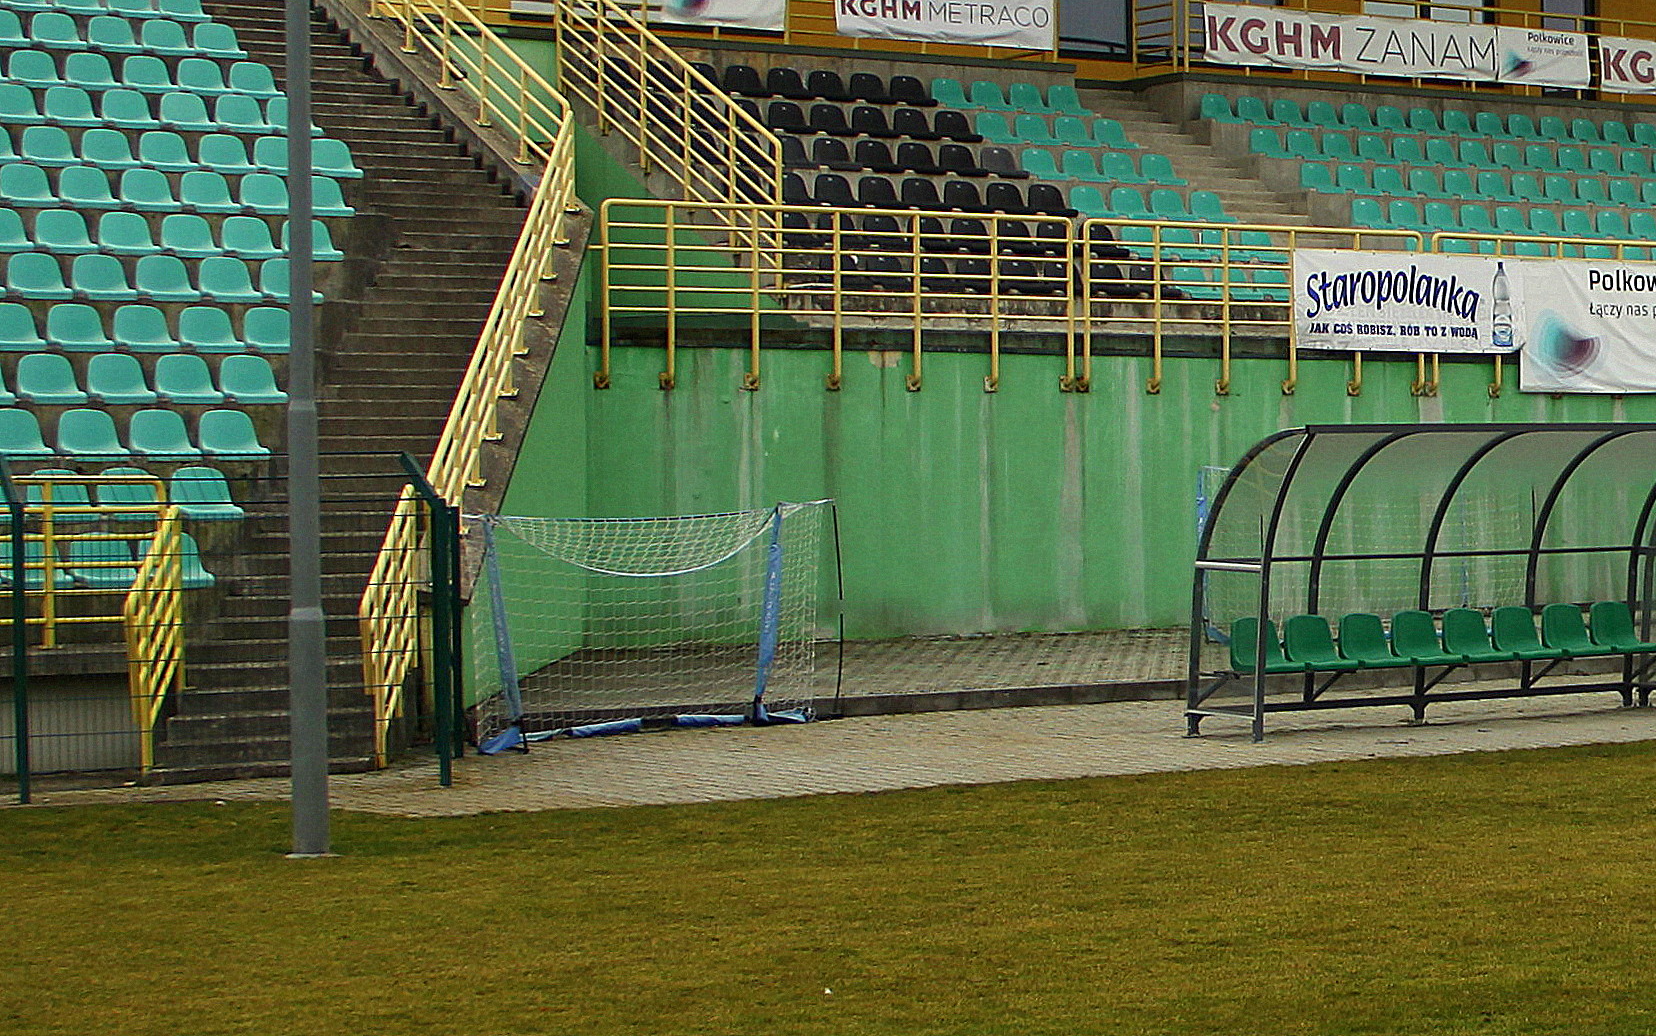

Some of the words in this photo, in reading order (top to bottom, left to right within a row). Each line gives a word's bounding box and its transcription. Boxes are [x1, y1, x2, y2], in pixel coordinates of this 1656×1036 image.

[929, 1, 1049, 28] METRACO
[1208, 15, 1342, 60] KGHM
[1355, 27, 1496, 70] ZANAM
[1528, 32, 1575, 45] Polkowice
[1306, 265, 1480, 323] Staropolanka
[1589, 302, 1623, 318] Łączy
[1627, 304, 1648, 317] nas
[1309, 323, 1329, 333] JAK
[1424, 326, 1437, 337] TO
[1441, 326, 1447, 337] Z
